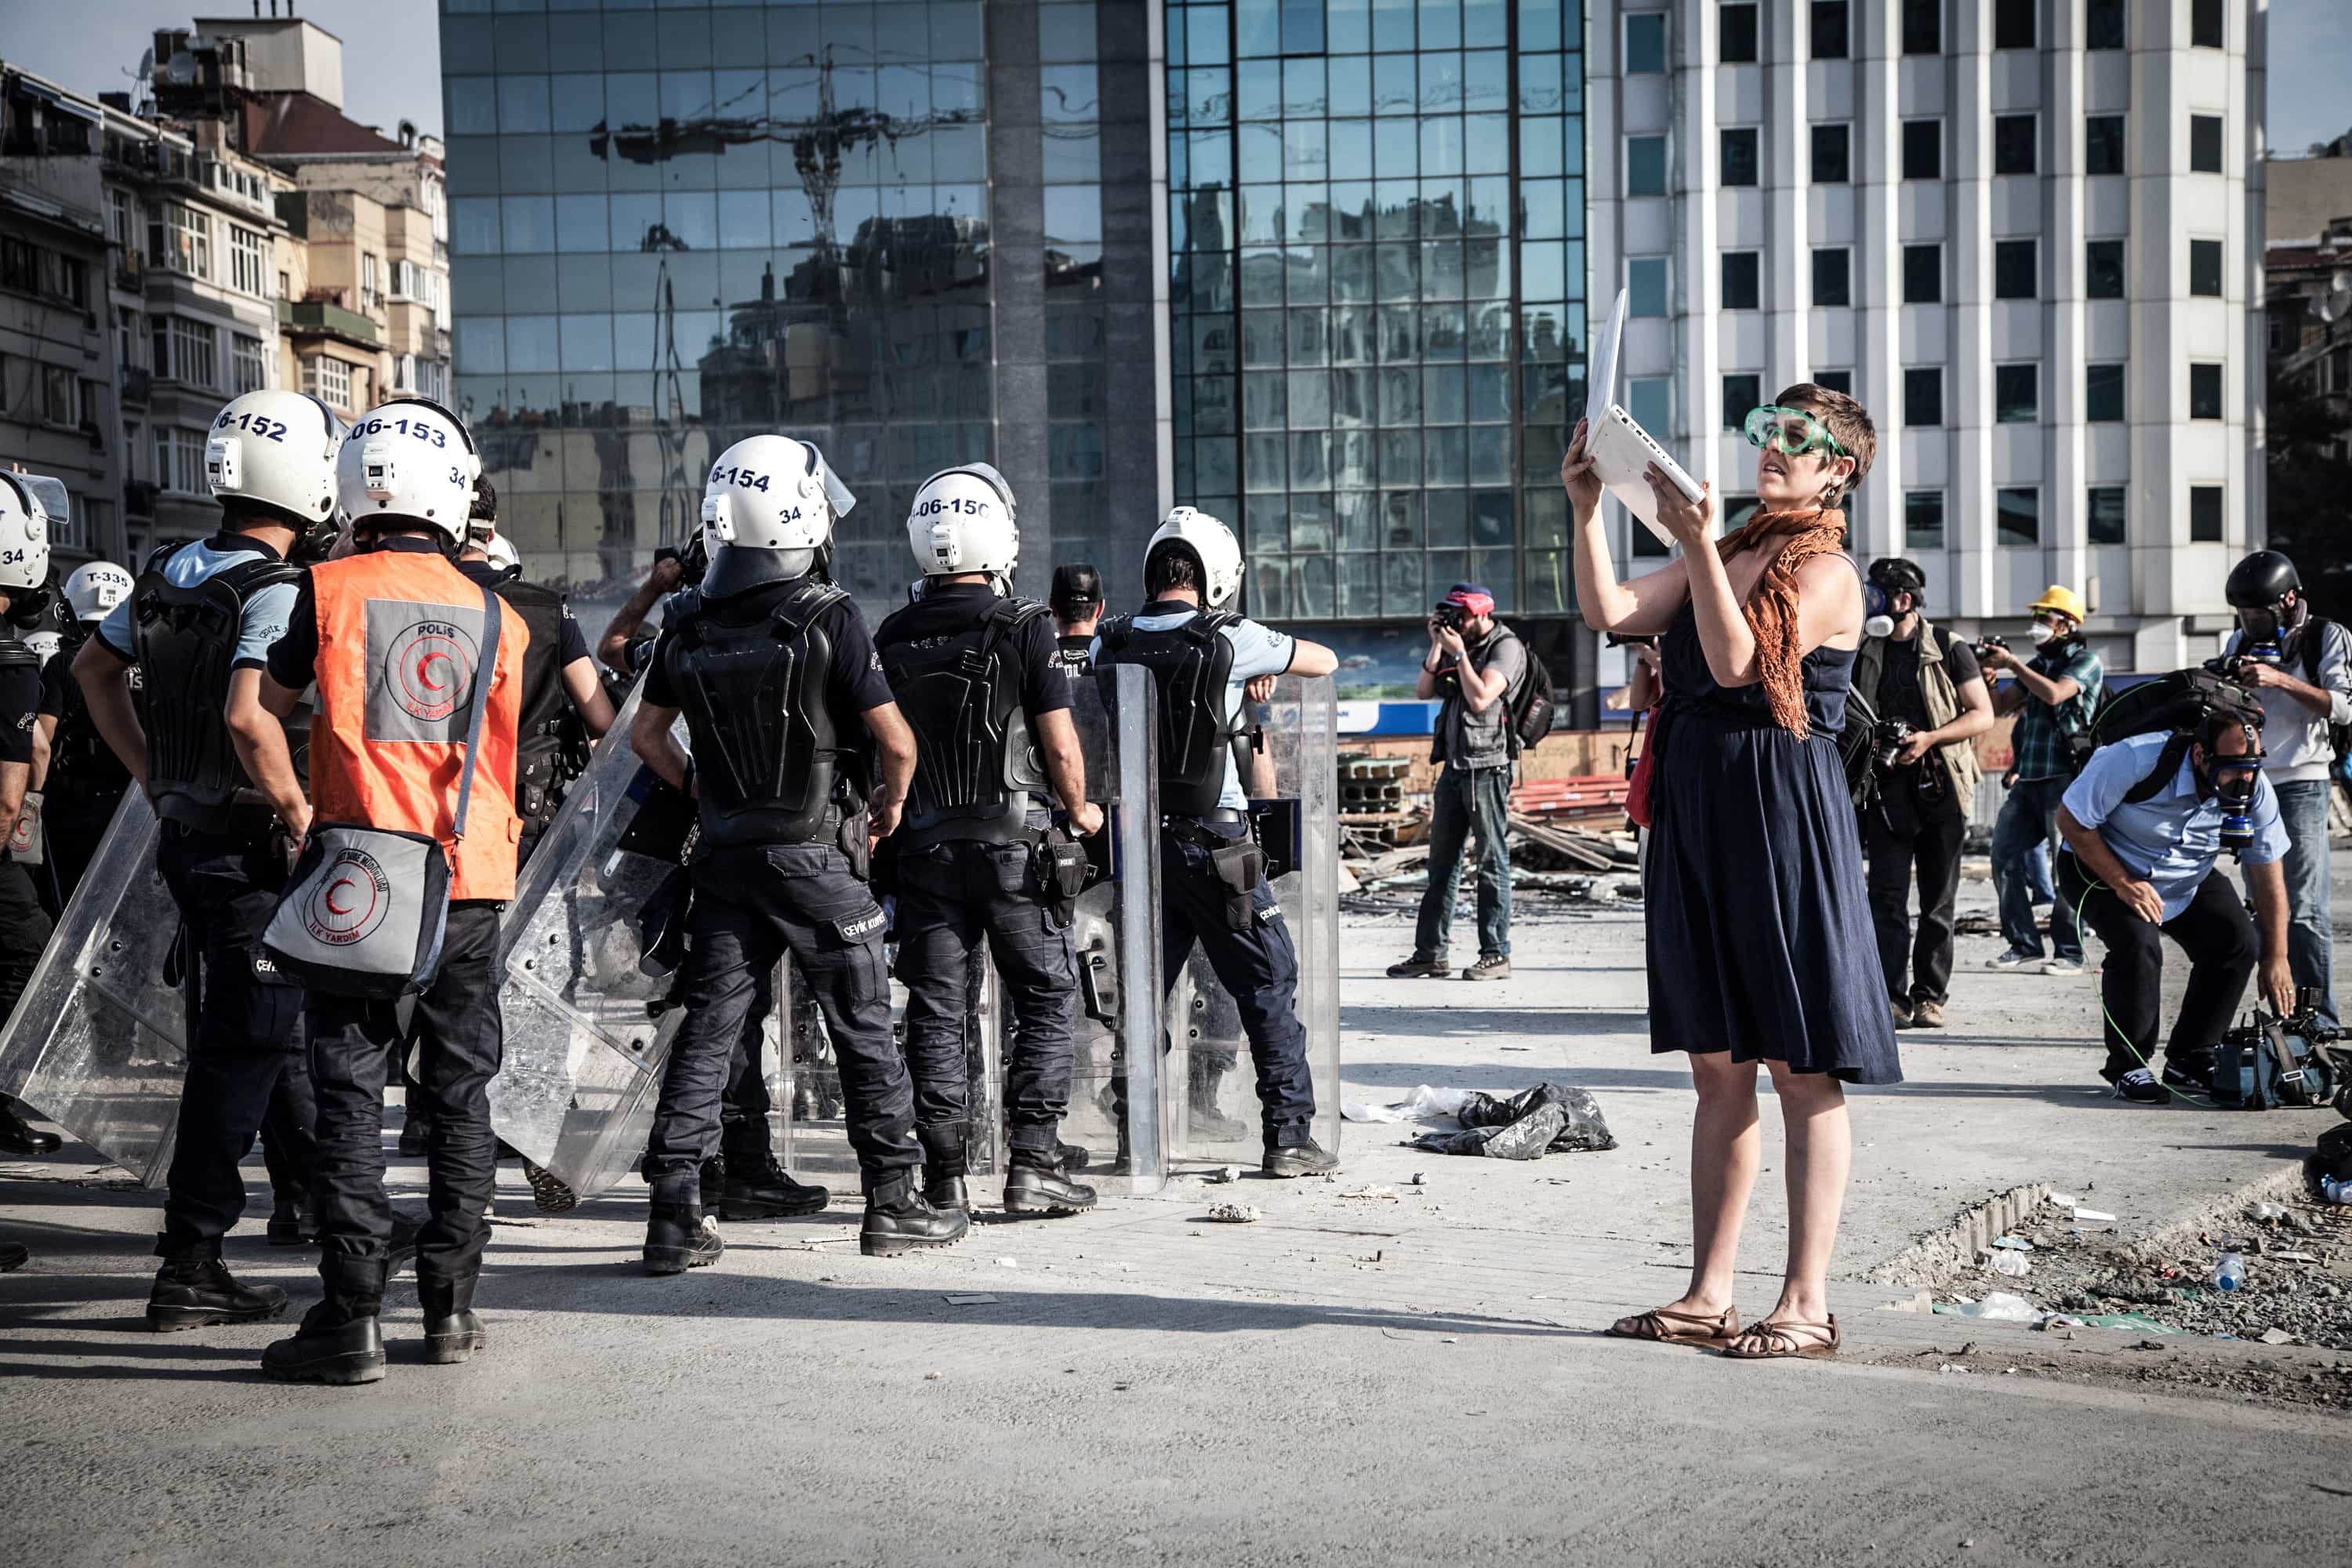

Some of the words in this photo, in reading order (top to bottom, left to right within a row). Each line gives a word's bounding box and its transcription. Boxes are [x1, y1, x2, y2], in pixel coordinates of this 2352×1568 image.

[449, 466, 466, 489] 34
[779, 506, 801, 524] 34
[2, 549, 24, 564] 34
[87, 572, 128, 587] T-335
